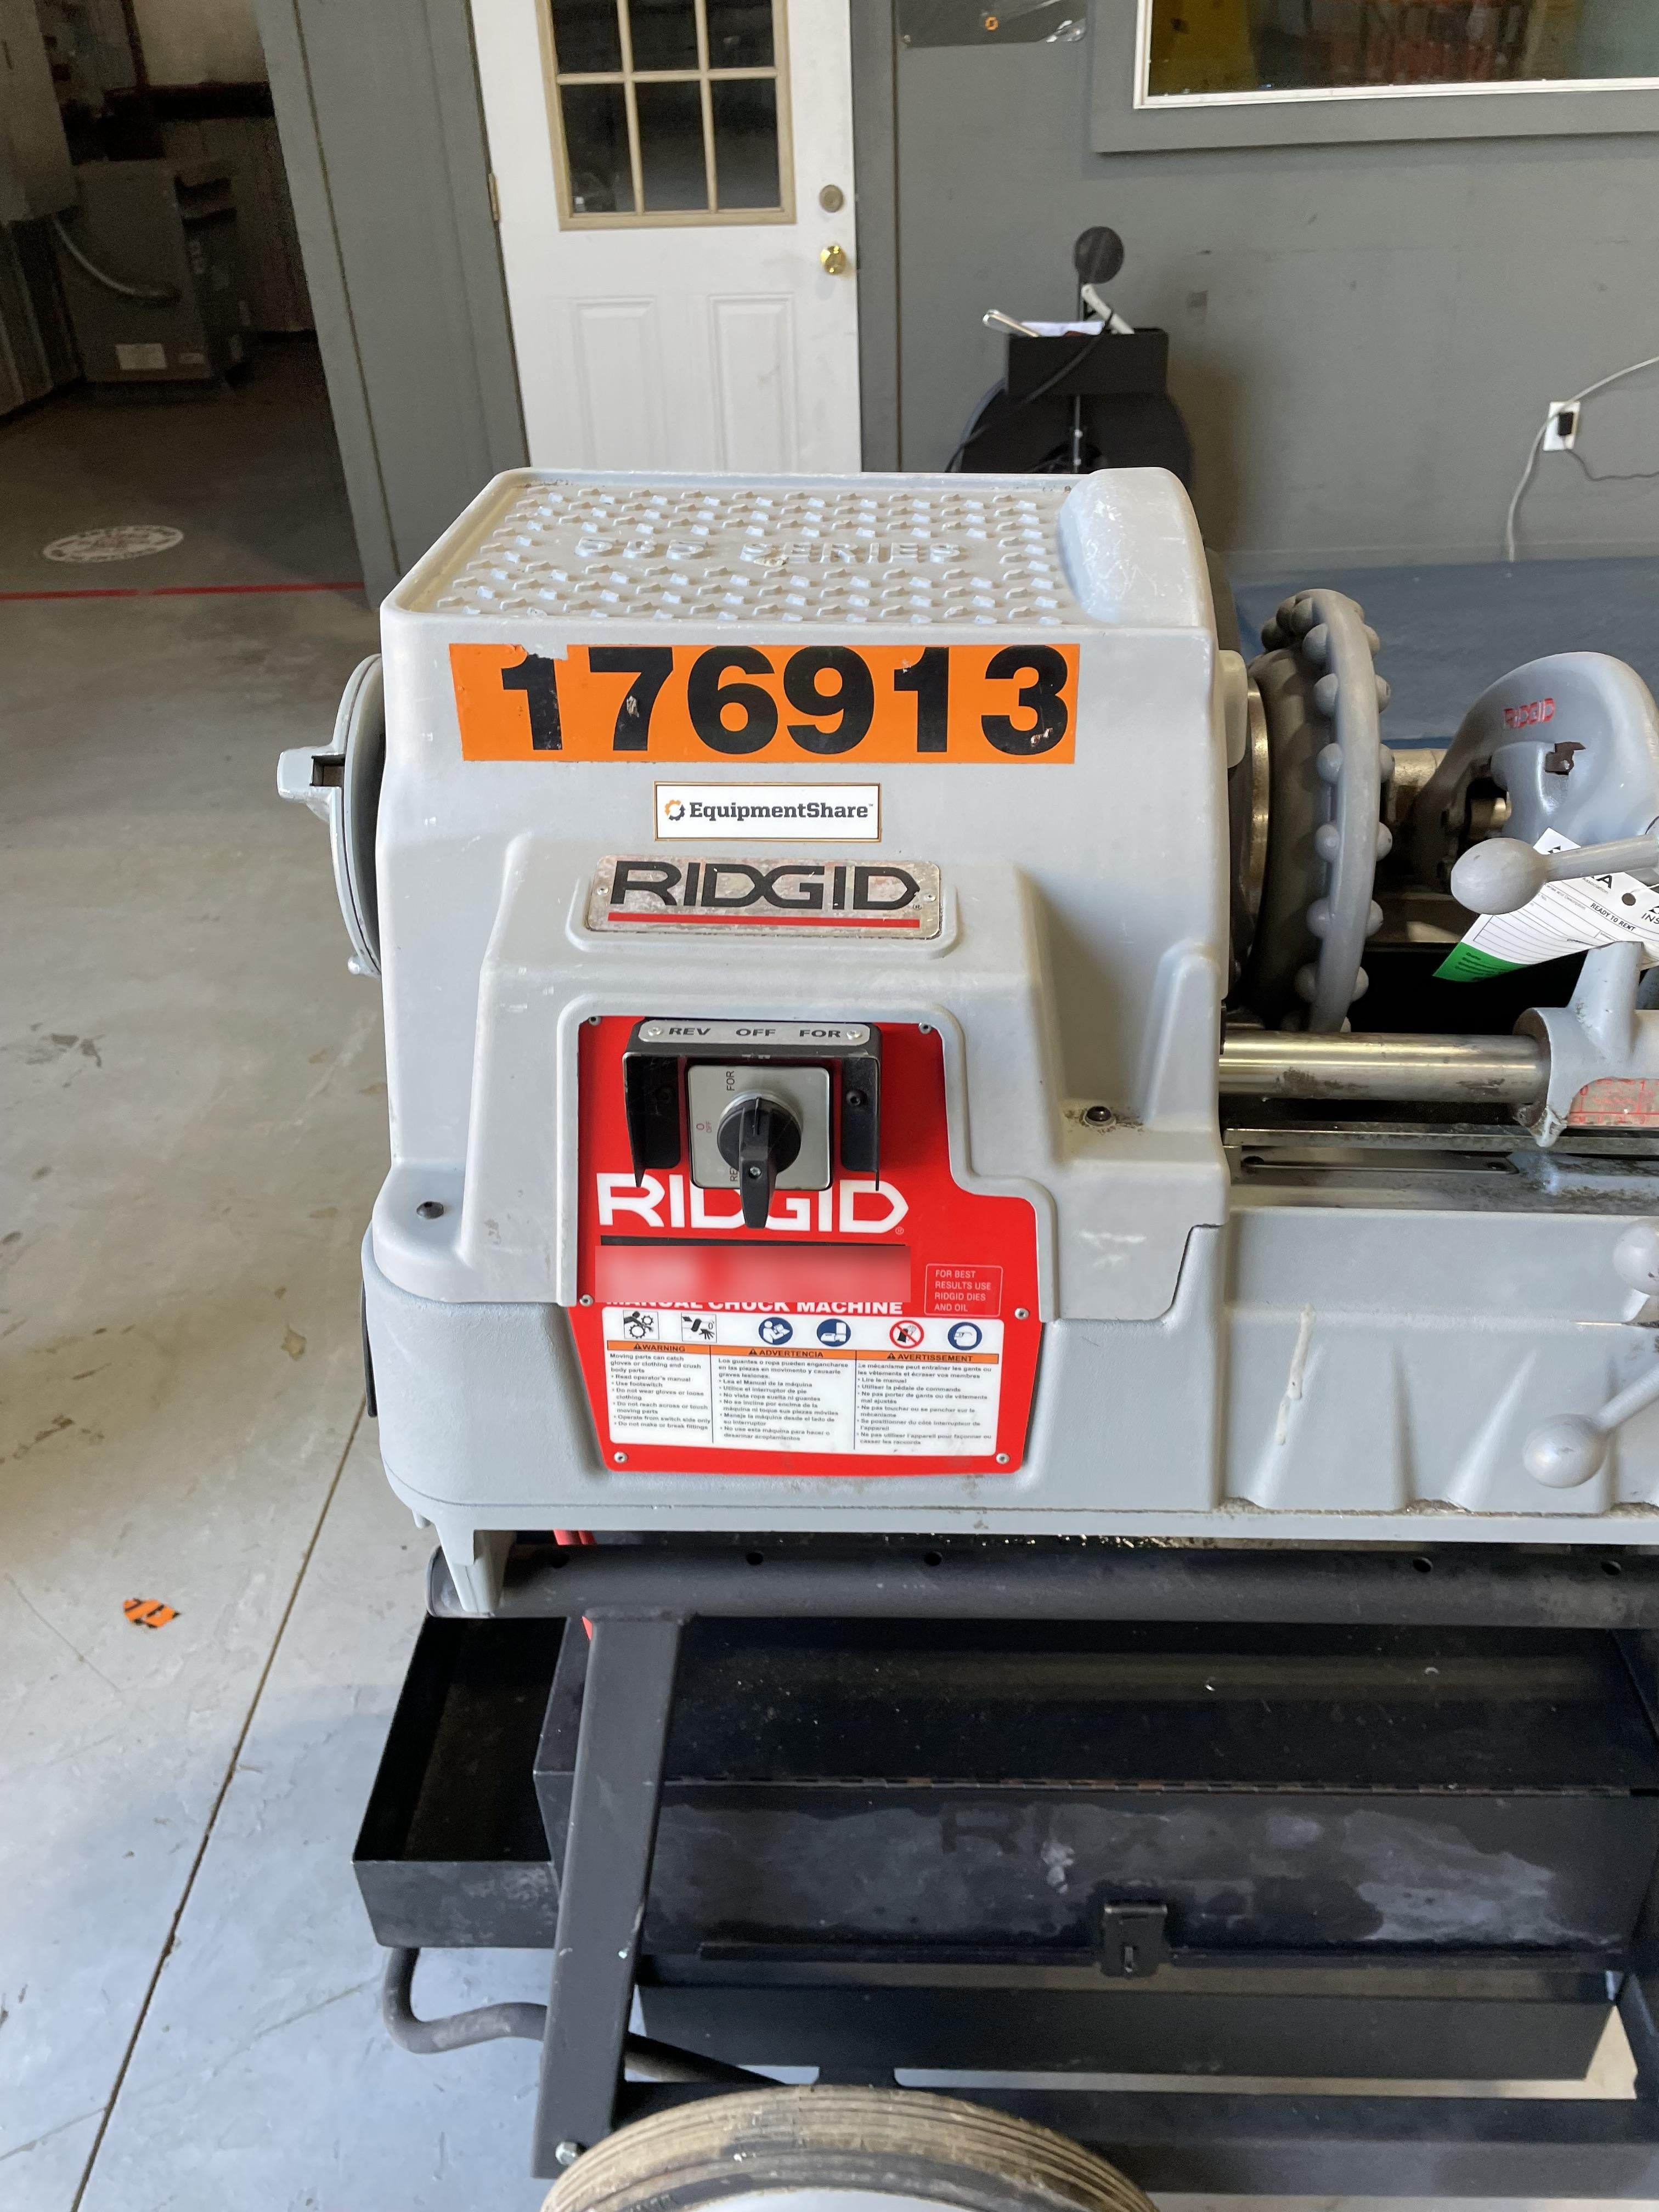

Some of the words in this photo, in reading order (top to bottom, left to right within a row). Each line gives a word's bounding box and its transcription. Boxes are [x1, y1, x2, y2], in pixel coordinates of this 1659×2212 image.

[501, 644, 1068, 756] 176913
[1504, 698, 1556, 729] RIDGID
[689, 800, 868, 819] EquipmentShare
[610, 861, 921, 911] RIDGID
[1590, 902, 1610, 917] READY
[1618, 921, 1636, 931] RENT
[669, 1028, 711, 1036] REV
[736, 1028, 776, 1037] OFF
[799, 1030, 841, 1039] FOR
[726, 1071, 735, 1091] FOR
[729, 1167, 738, 1181] RE
[596, 1172, 909, 1234] RIDGID
[935, 1269, 952, 1278] FOR
[955, 1270, 975, 1278] BEST
[975, 1282, 991, 1290] USE
[935, 1292, 964, 1300] RIDGID
[708, 1302, 789, 1312] CHUCK
[797, 1302, 903, 1314] MACHINE
[759, 1350, 823, 1358] ADVERTENCIA
[898, 1353, 973, 1362] AVERTISSEMENT
